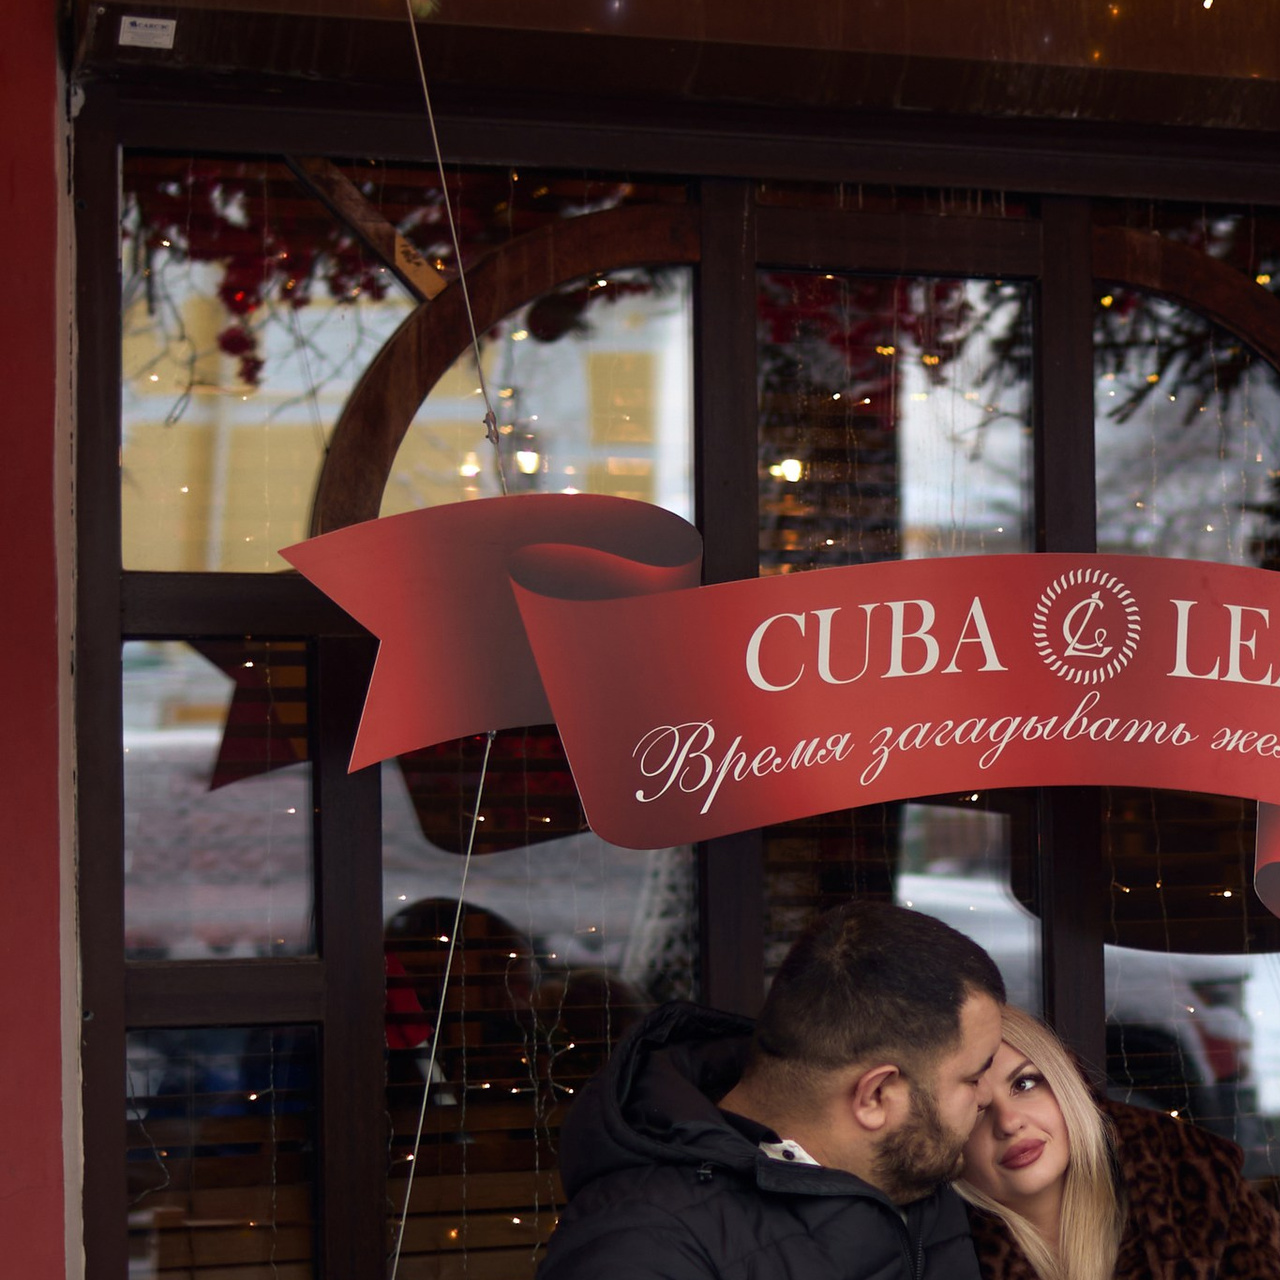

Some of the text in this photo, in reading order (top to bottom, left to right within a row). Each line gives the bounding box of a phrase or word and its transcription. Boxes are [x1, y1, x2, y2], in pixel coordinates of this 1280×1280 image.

[745, 595, 1009, 692] CUBA
[631, 718, 855, 815] Время
[858, 690, 1199, 787] загадывать
